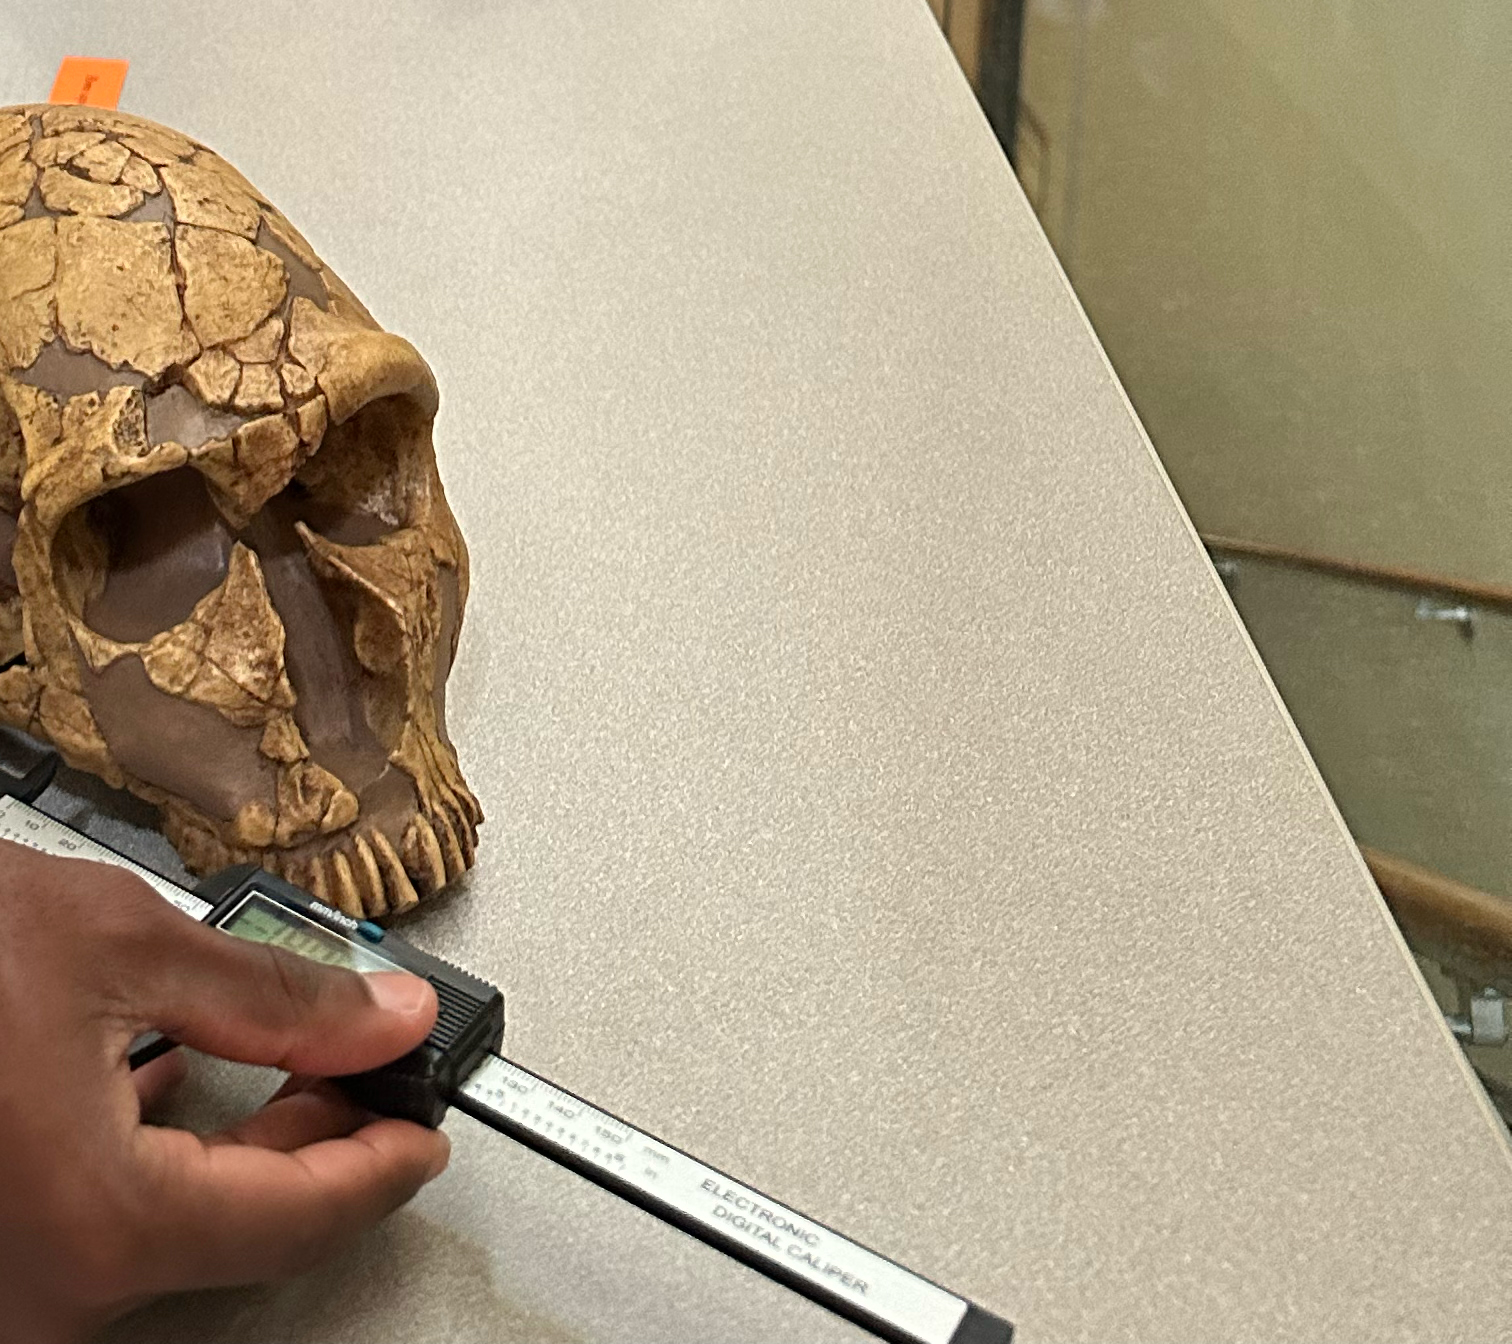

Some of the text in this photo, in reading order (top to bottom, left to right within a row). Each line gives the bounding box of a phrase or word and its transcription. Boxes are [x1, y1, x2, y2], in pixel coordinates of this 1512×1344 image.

[24, 819, 40, 832] 10
[58, 838, 78, 852] 20
[309, 901, 358, 931] mm/inch
[501, 1076, 529, 1094] 130
[547, 1100, 577, 1119] 140
[594, 1126, 623, 1145] 150
[700, 1178, 820, 1248] ELECTRONIC
[712, 1205, 869, 1293] DIGITAL CALIPER
